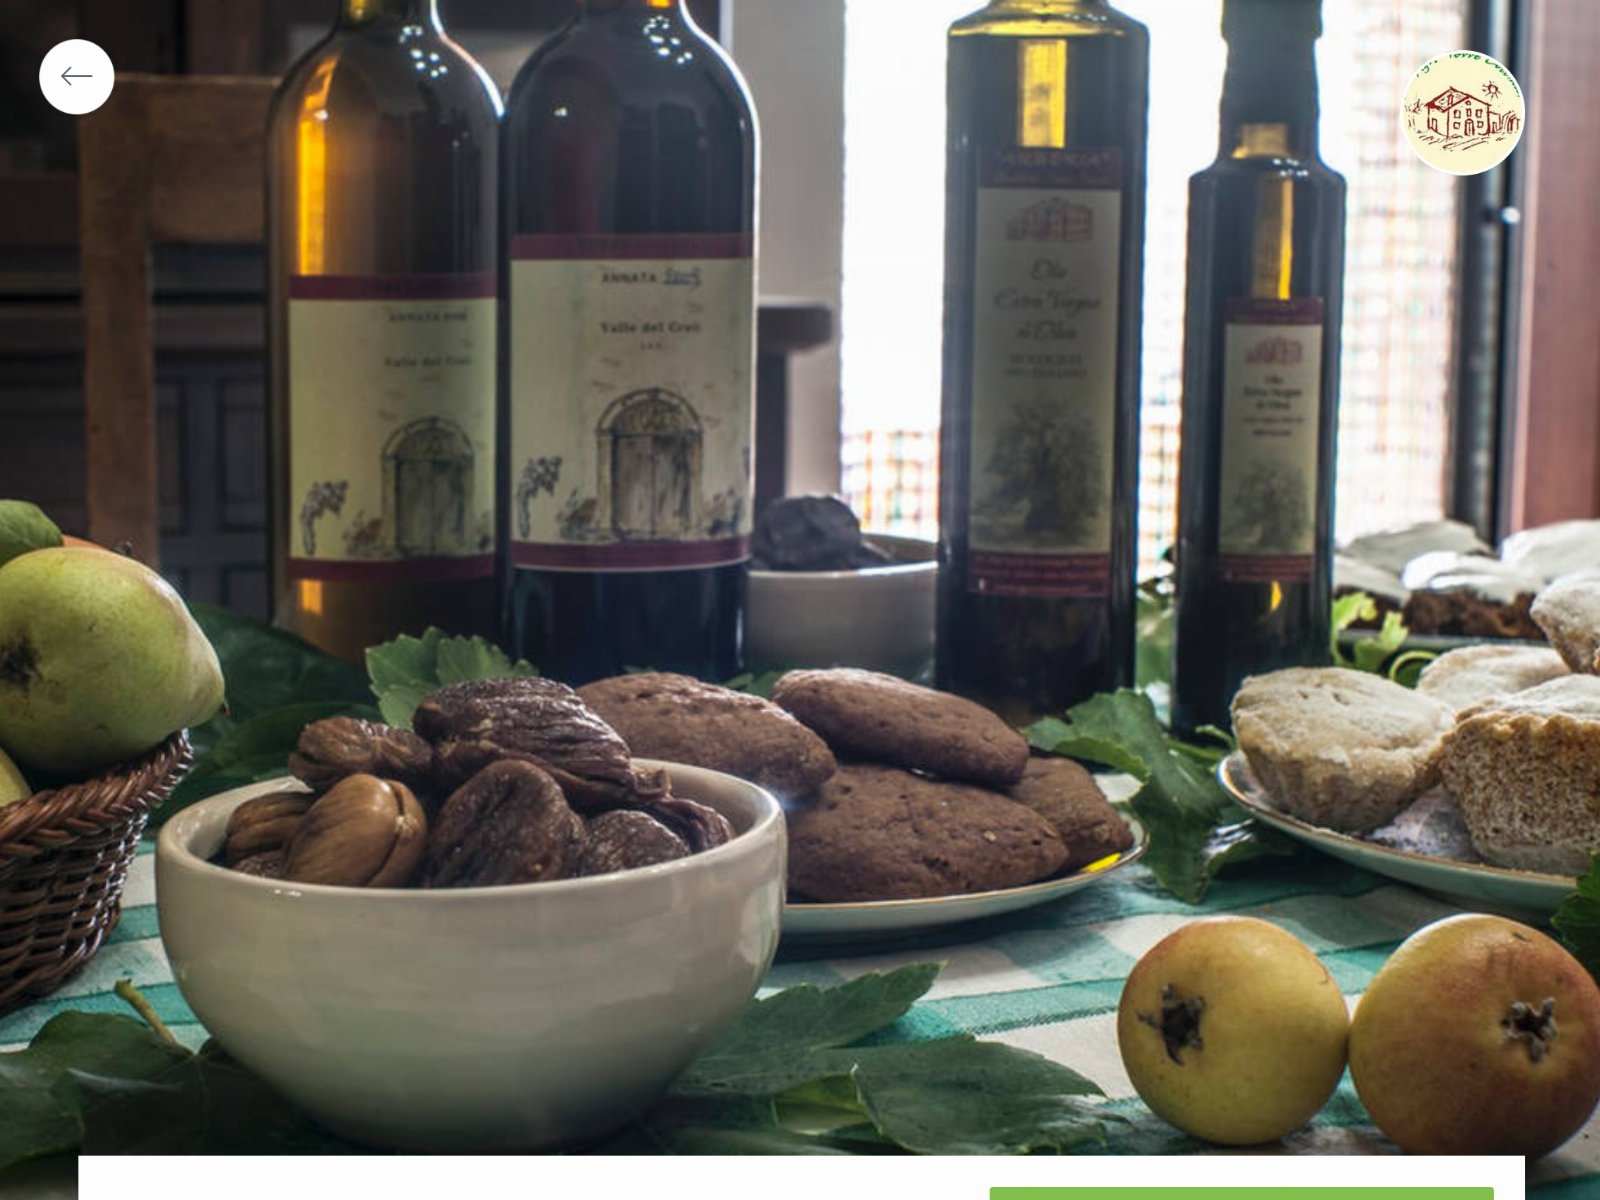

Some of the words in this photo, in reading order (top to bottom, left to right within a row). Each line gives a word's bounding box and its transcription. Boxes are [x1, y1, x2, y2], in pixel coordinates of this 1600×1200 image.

[601, 271, 657, 284] ANNATA
[599, 321, 637, 334] Valle
[641, 320, 665, 334] del
